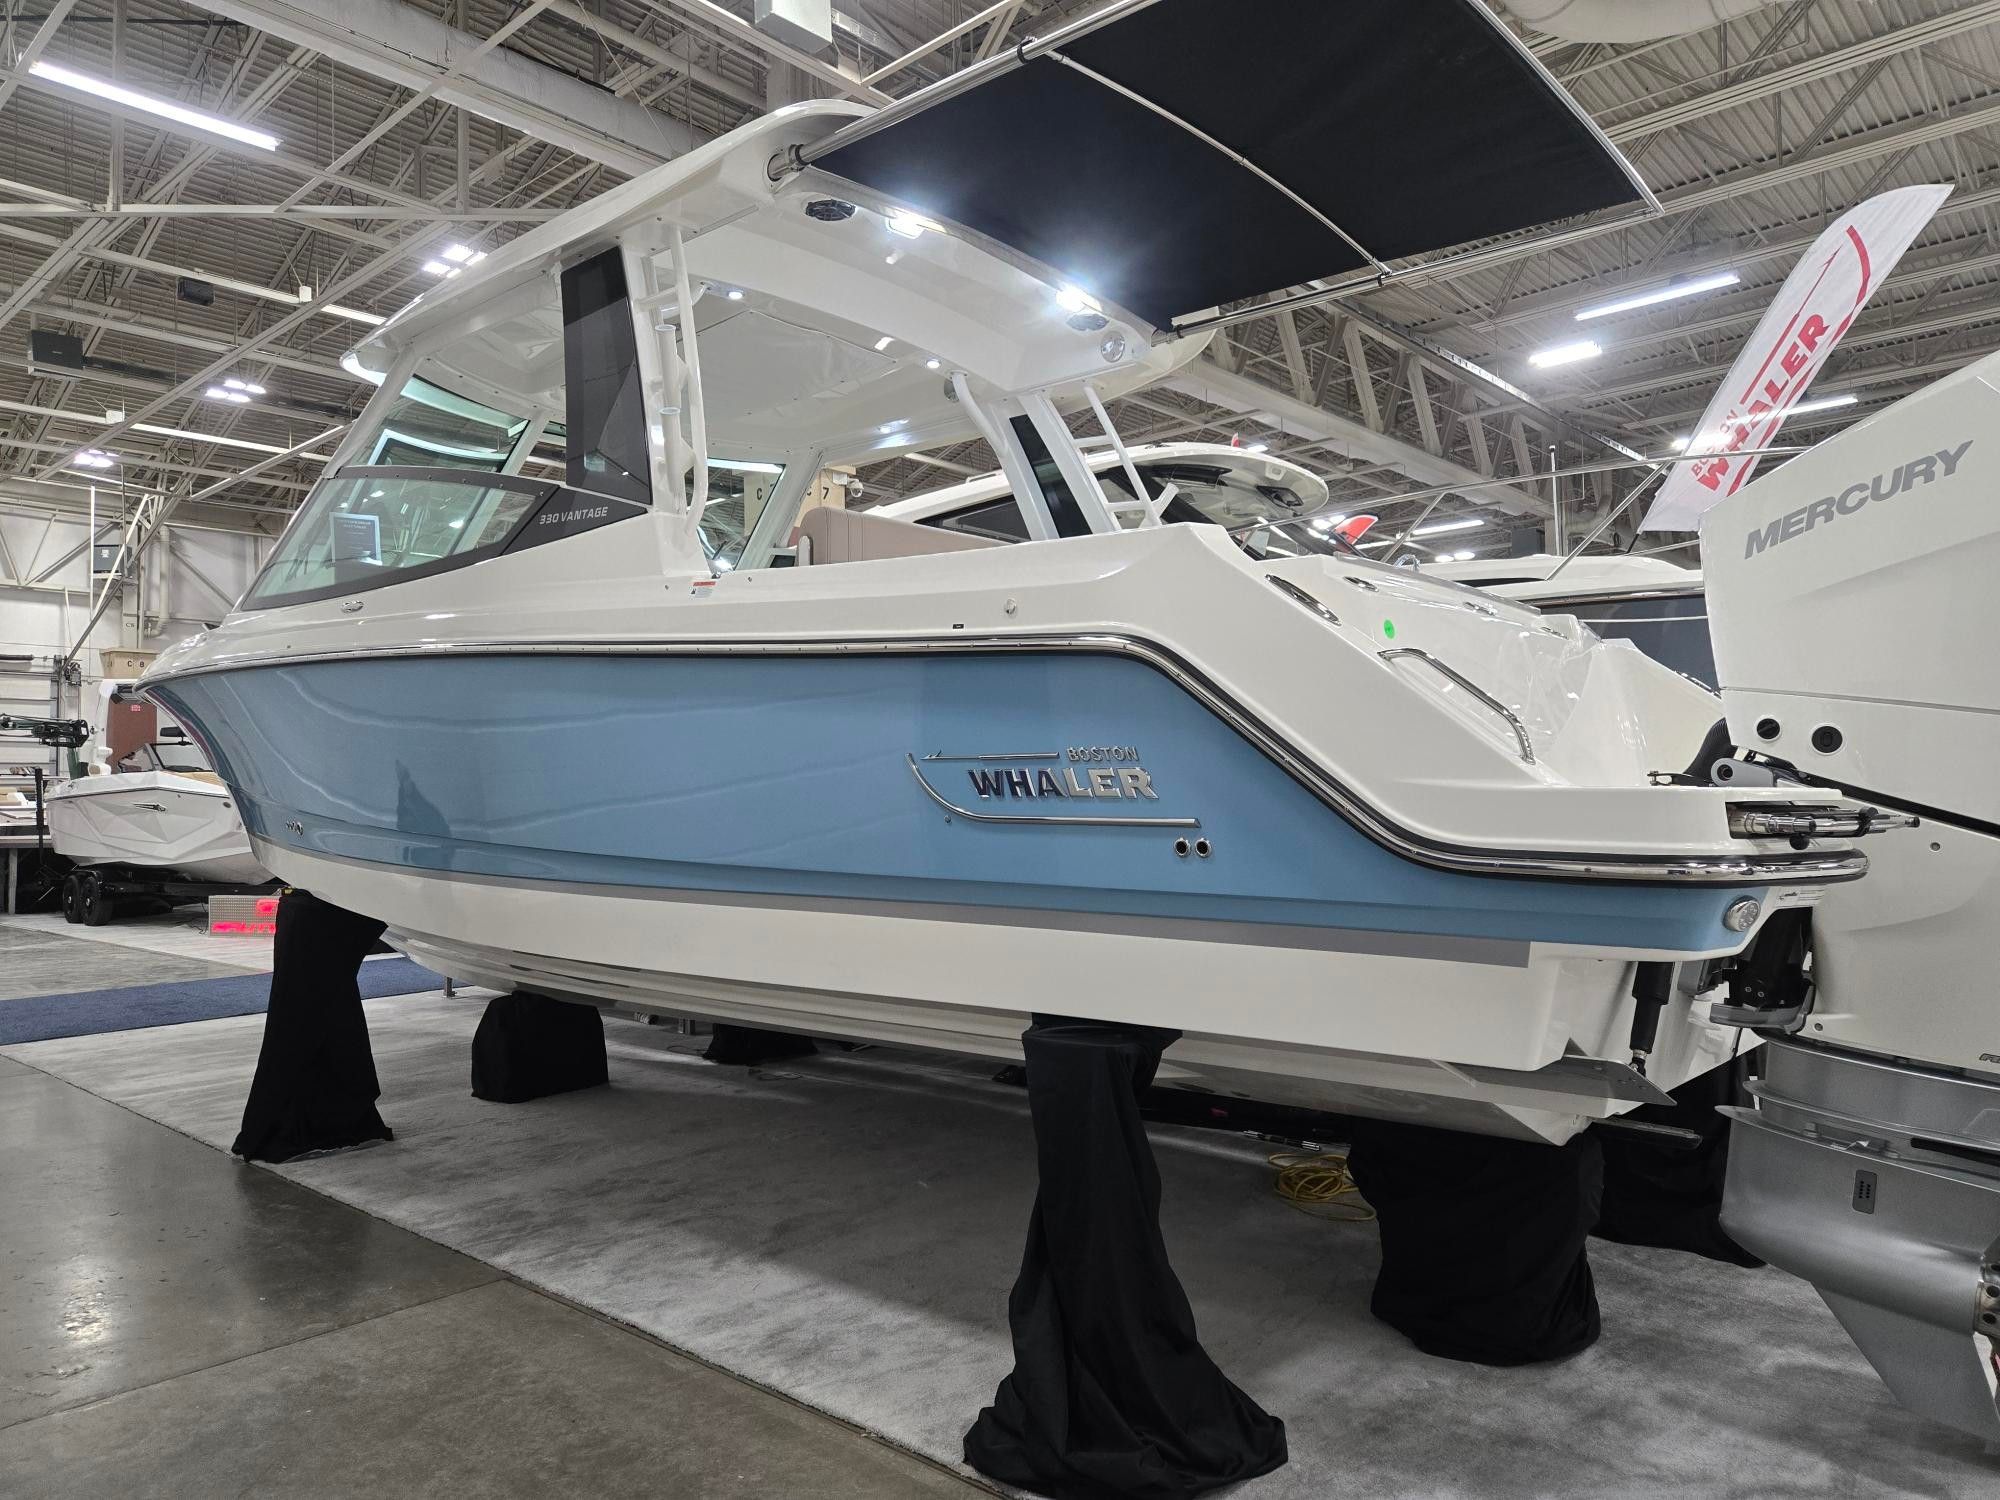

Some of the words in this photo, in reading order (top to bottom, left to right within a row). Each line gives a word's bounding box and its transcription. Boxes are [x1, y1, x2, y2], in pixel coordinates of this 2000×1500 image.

[1697, 313, 1830, 491] WHALER
[539, 513, 559, 525] 330
[561, 506, 608, 522] VANTAGE
[1744, 439, 1974, 559] MERCURY
[1067, 746, 1139, 761] BOSTON
[968, 767, 1159, 800] WHALER
